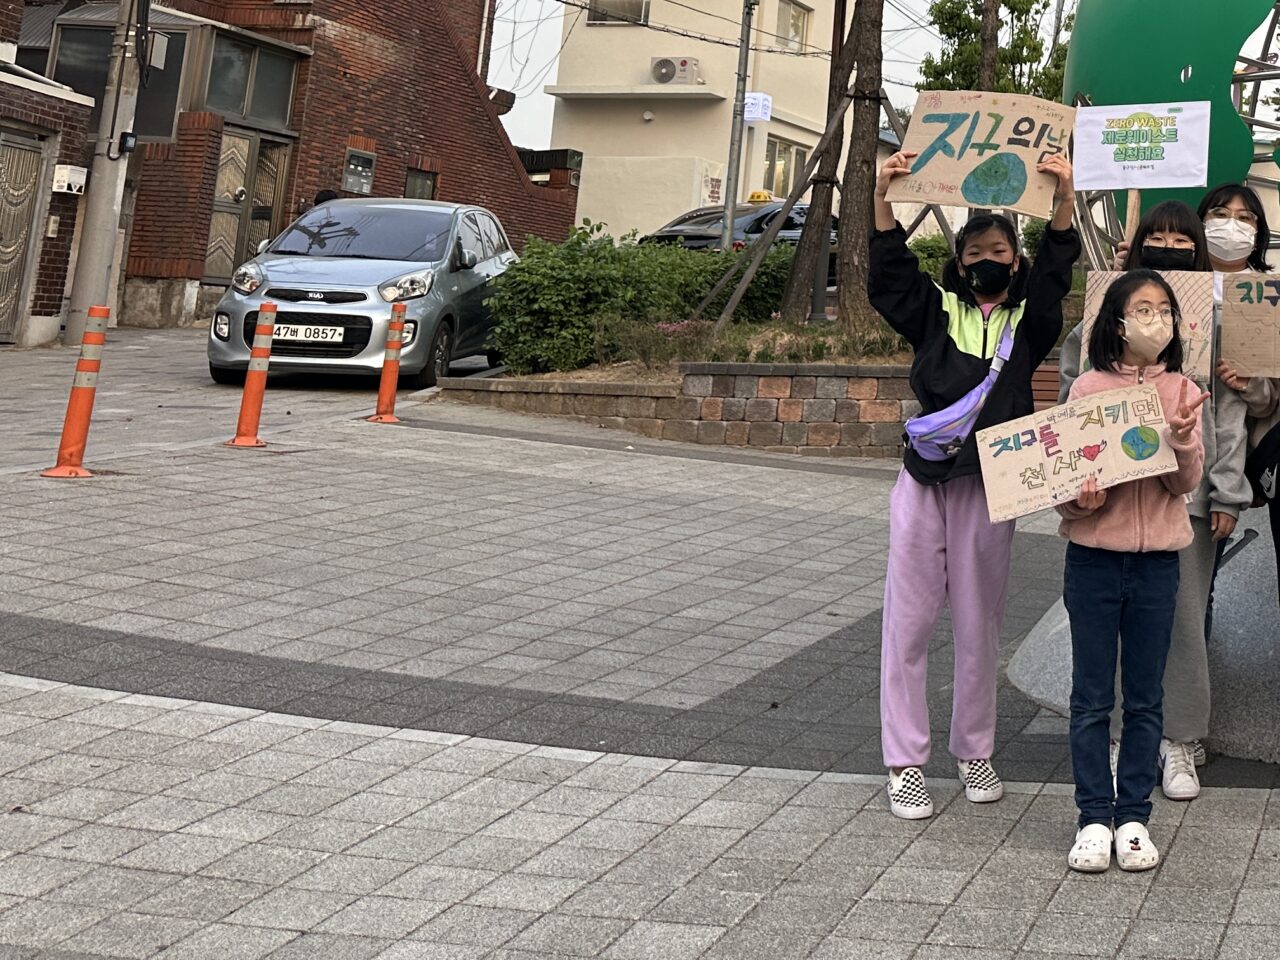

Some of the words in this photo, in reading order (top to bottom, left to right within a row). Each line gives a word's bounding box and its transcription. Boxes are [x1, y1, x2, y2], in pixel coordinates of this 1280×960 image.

[1105, 118, 1134, 129] ZERO
[1136, 116, 1177, 127] WASTE
[1101, 128, 1178, 145] 제로웨이스트
[1113, 146, 1165, 162] 실천해요
[304, 327, 337, 340] 0857
[1076, 394, 1163, 430] 지키면
[1020, 450, 1081, 490] 천사
